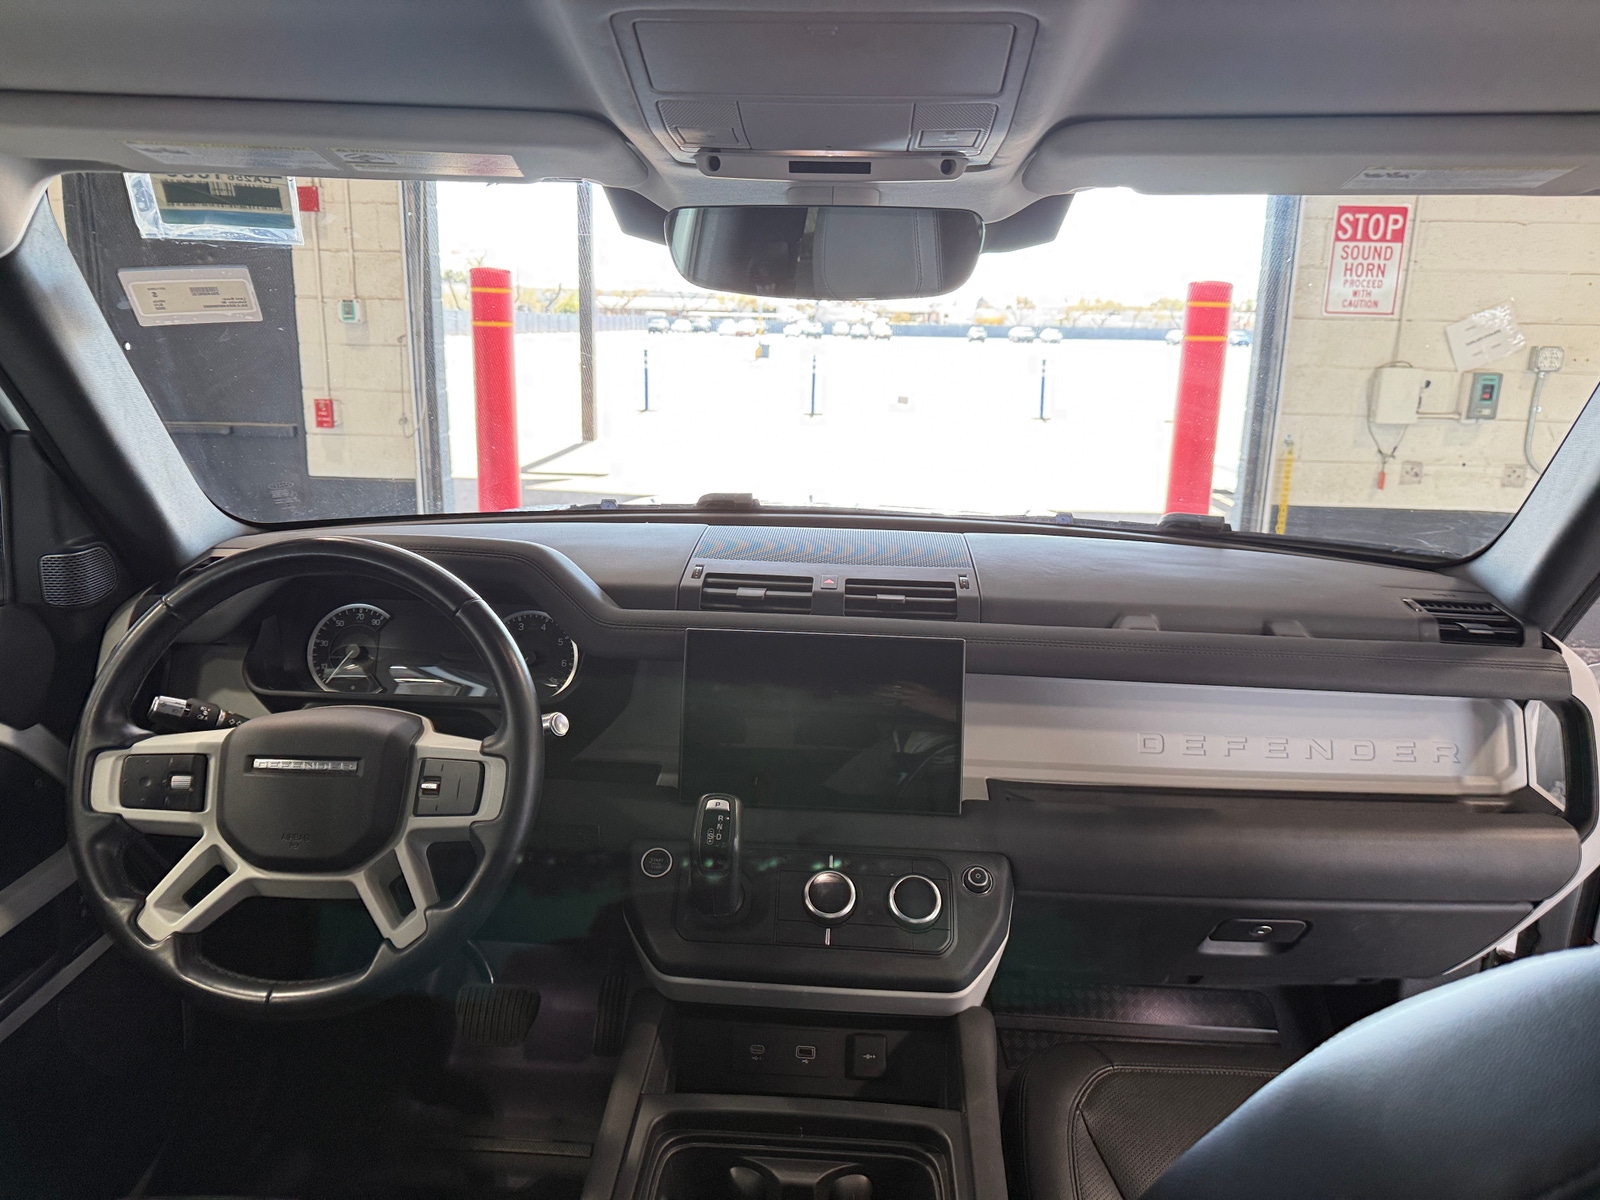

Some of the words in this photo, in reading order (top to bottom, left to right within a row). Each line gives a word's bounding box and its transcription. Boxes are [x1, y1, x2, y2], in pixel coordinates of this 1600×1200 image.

[1337, 213, 1404, 240] STOP
[1340, 245, 1393, 261] SOUND
[1343, 262, 1386, 278] HORN
[1343, 279, 1383, 289] PROCEED
[1351, 289, 1372, 298] WITH
[1341, 299, 1379, 309] CAUTION
[518, 622, 525, 631] 3
[540, 623, 546, 631] 4
[558, 638, 564, 646] 5
[561, 659, 567, 667] 6
[1138, 732, 1461, 764] DEFENDER
[254, 759, 357, 771] DEFENDER
[717, 814, 724, 822] R
[716, 833, 722, 841] D
